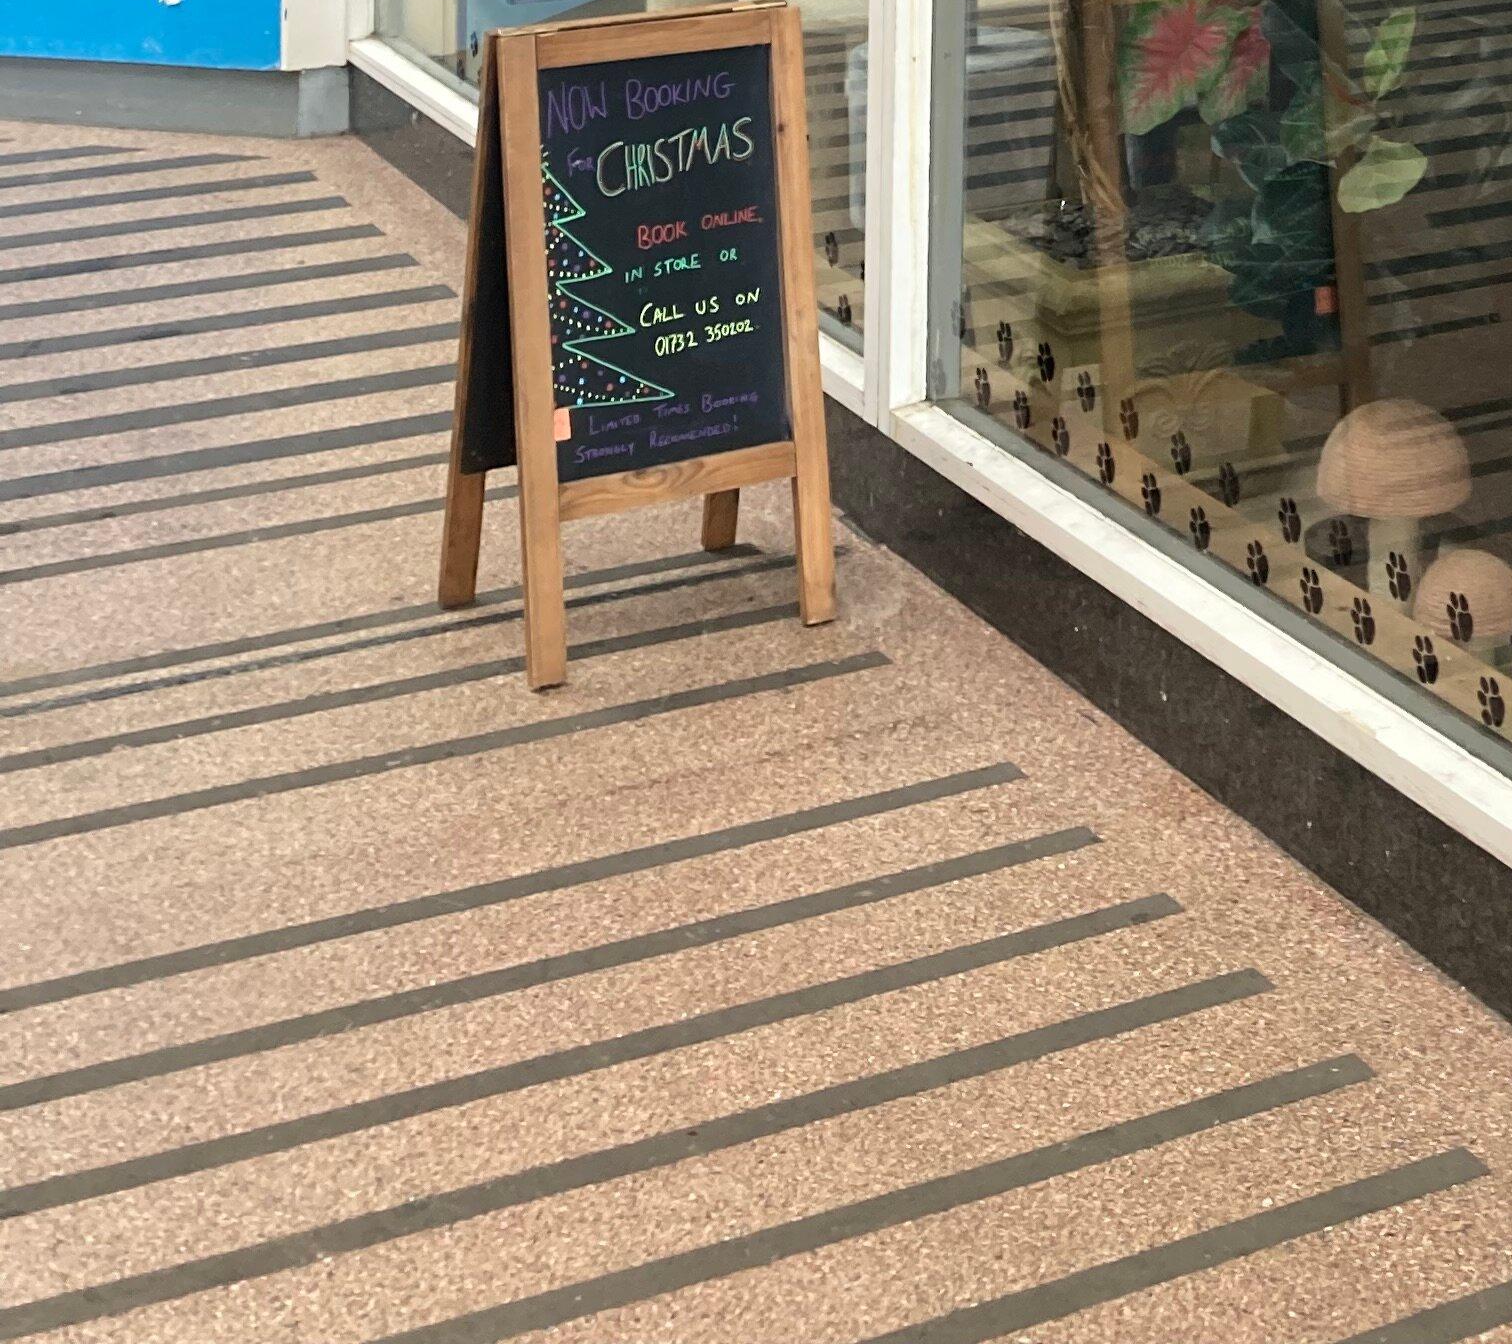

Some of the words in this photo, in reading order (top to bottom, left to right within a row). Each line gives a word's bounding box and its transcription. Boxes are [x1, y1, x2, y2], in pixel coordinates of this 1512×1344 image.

[546, 81, 608, 139] NOW
[625, 72, 737, 120] BOOKING
[596, 116, 754, 197] CHRISTMAS
[637, 220, 688, 250] BOOK
[624, 266, 643, 284] IN
[653, 253, 701, 278] STORE
[719, 247, 738, 262] OR
[639, 302, 686, 328] CALL
[695, 296, 720, 315] US
[735, 287, 760, 306] ON
[654, 330, 699, 357] 01732
[704, 318, 754, 343] 350202
[589, 414, 641, 435] LIMITED
[652, 402, 690, 418] TIMES
[701, 391, 759, 413] BOOKING
[573, 441, 635, 464] STRONGLY
